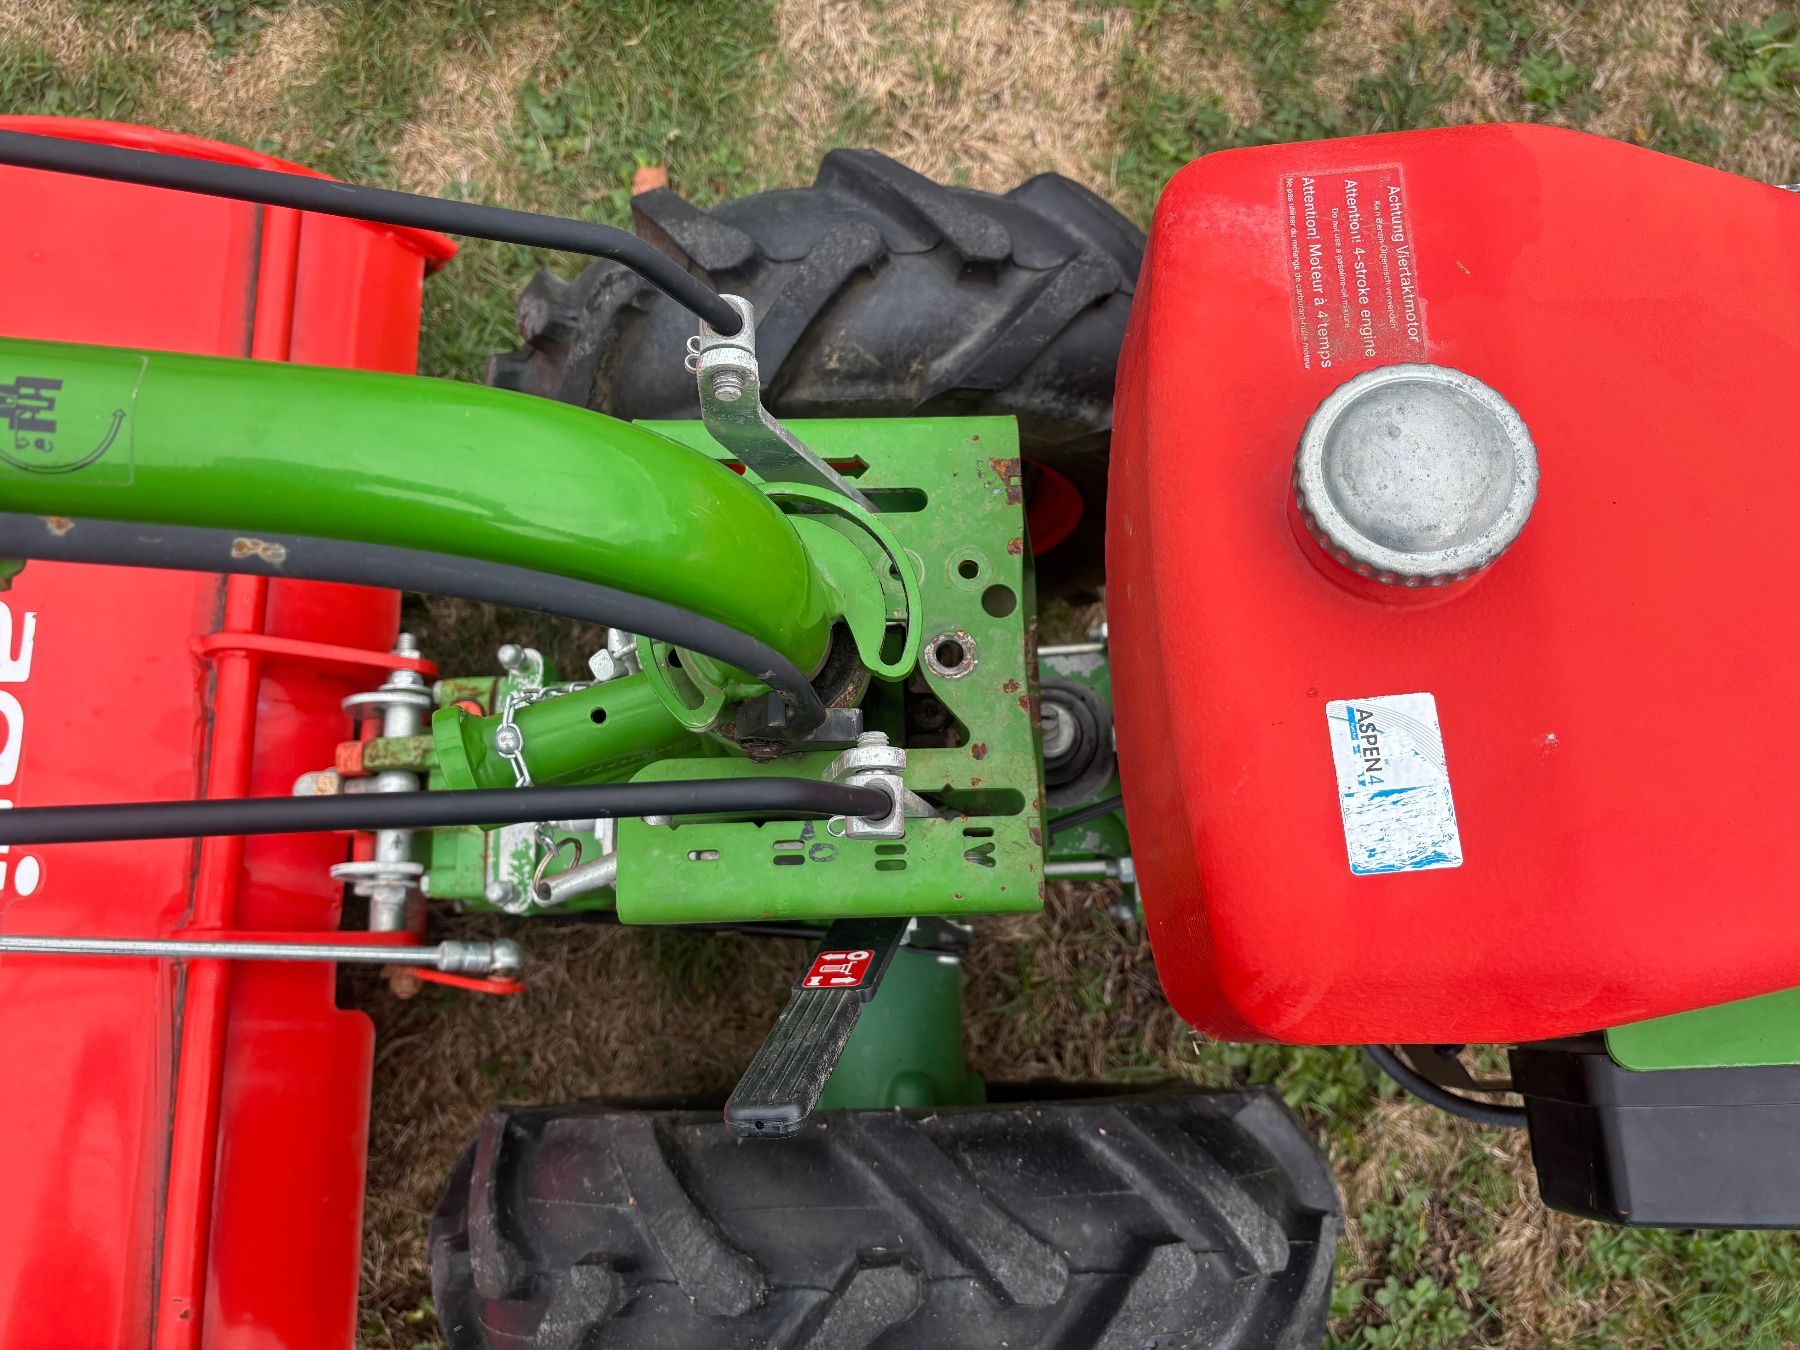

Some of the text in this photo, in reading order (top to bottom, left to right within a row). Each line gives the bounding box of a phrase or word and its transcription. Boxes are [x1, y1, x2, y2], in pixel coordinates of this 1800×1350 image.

[1286, 177, 1293, 187] Ne
[1286, 188, 1295, 201] pas
[1331, 207, 1339, 218] Do
[1290, 228, 1298, 238] du
[1301, 177, 1332, 368] Attention! Moteur à 4 temps
[1344, 179, 1377, 357] Attention! 4-stroke engine
[1387, 185, 1419, 342] Achtung Viertaktmotor
[1294, 273, 1303, 282] de
[1302, 342, 1311, 370] moteur
[1356, 708, 1384, 785] ASPEN 4
